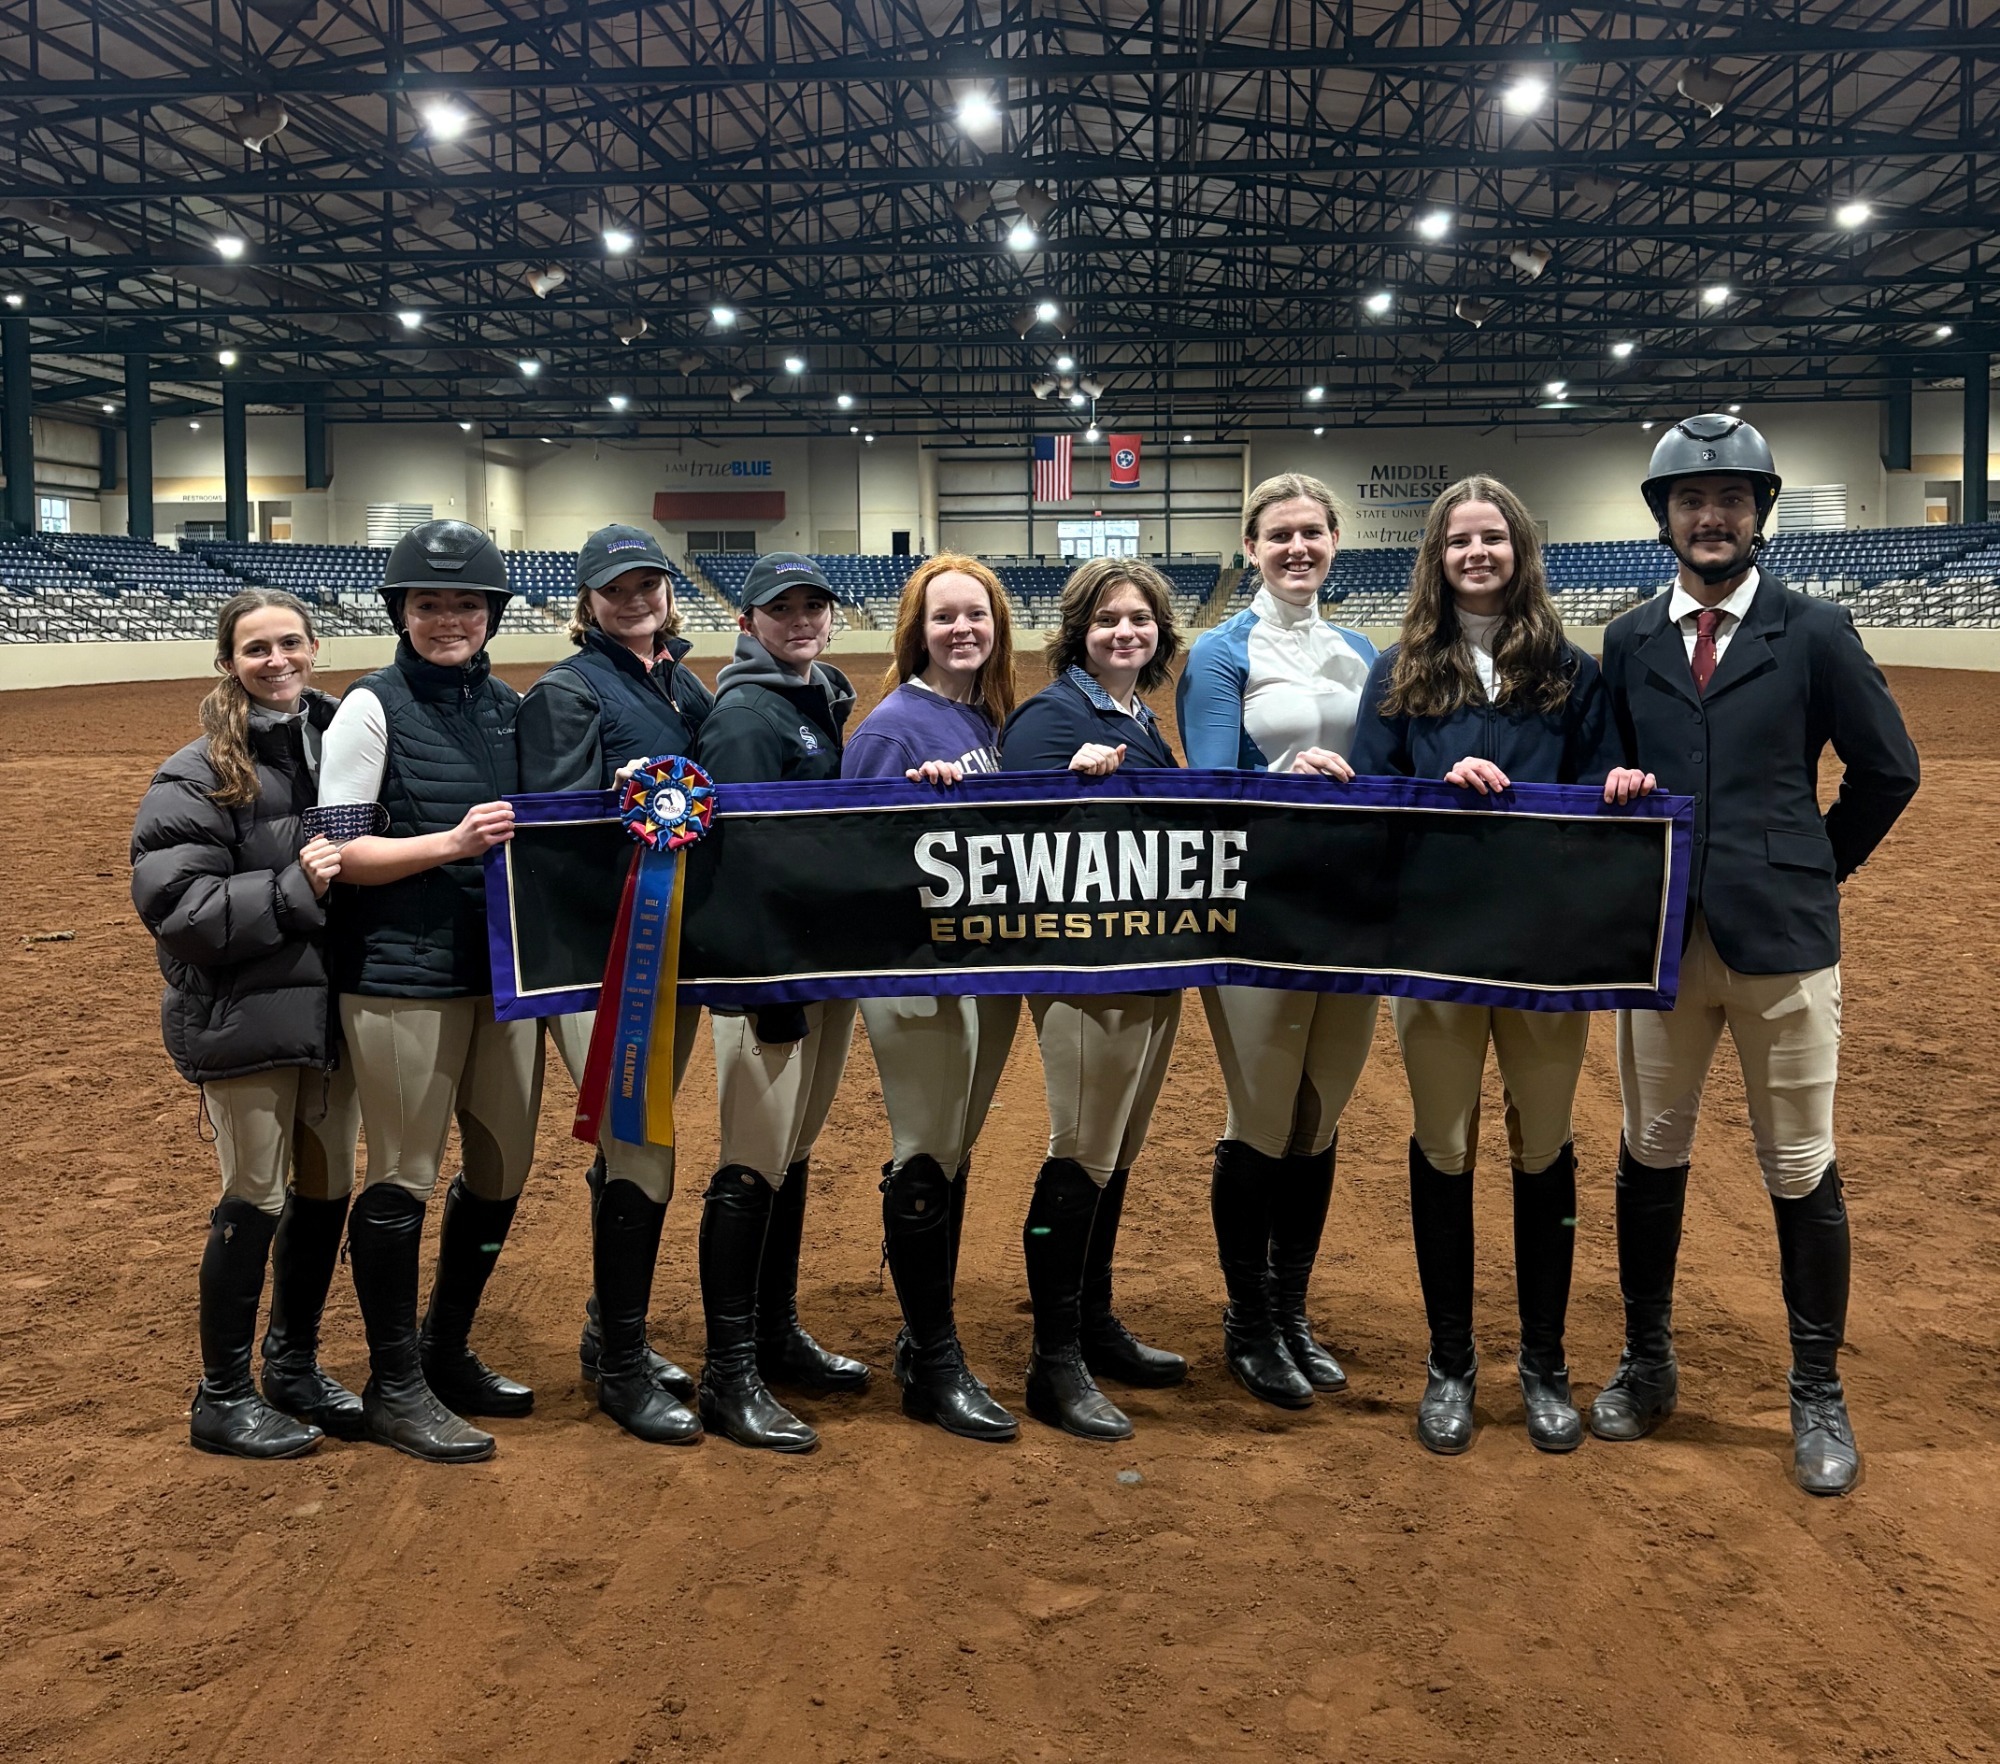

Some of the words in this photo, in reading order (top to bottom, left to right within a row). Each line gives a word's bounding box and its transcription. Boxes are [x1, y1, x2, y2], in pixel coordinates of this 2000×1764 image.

[671, 464, 689, 472] AM
[1371, 464, 1449, 480] MIDDLE
[1356, 510, 1387, 519] STATE
[1392, 509, 1428, 518] UNIVE
[1362, 531, 1379, 539] AM
[914, 830, 1248, 909] SEWANEE
[930, 908, 1237, 944] EQUESTRIAN
[622, 1043, 638, 1099] CHAMPION
